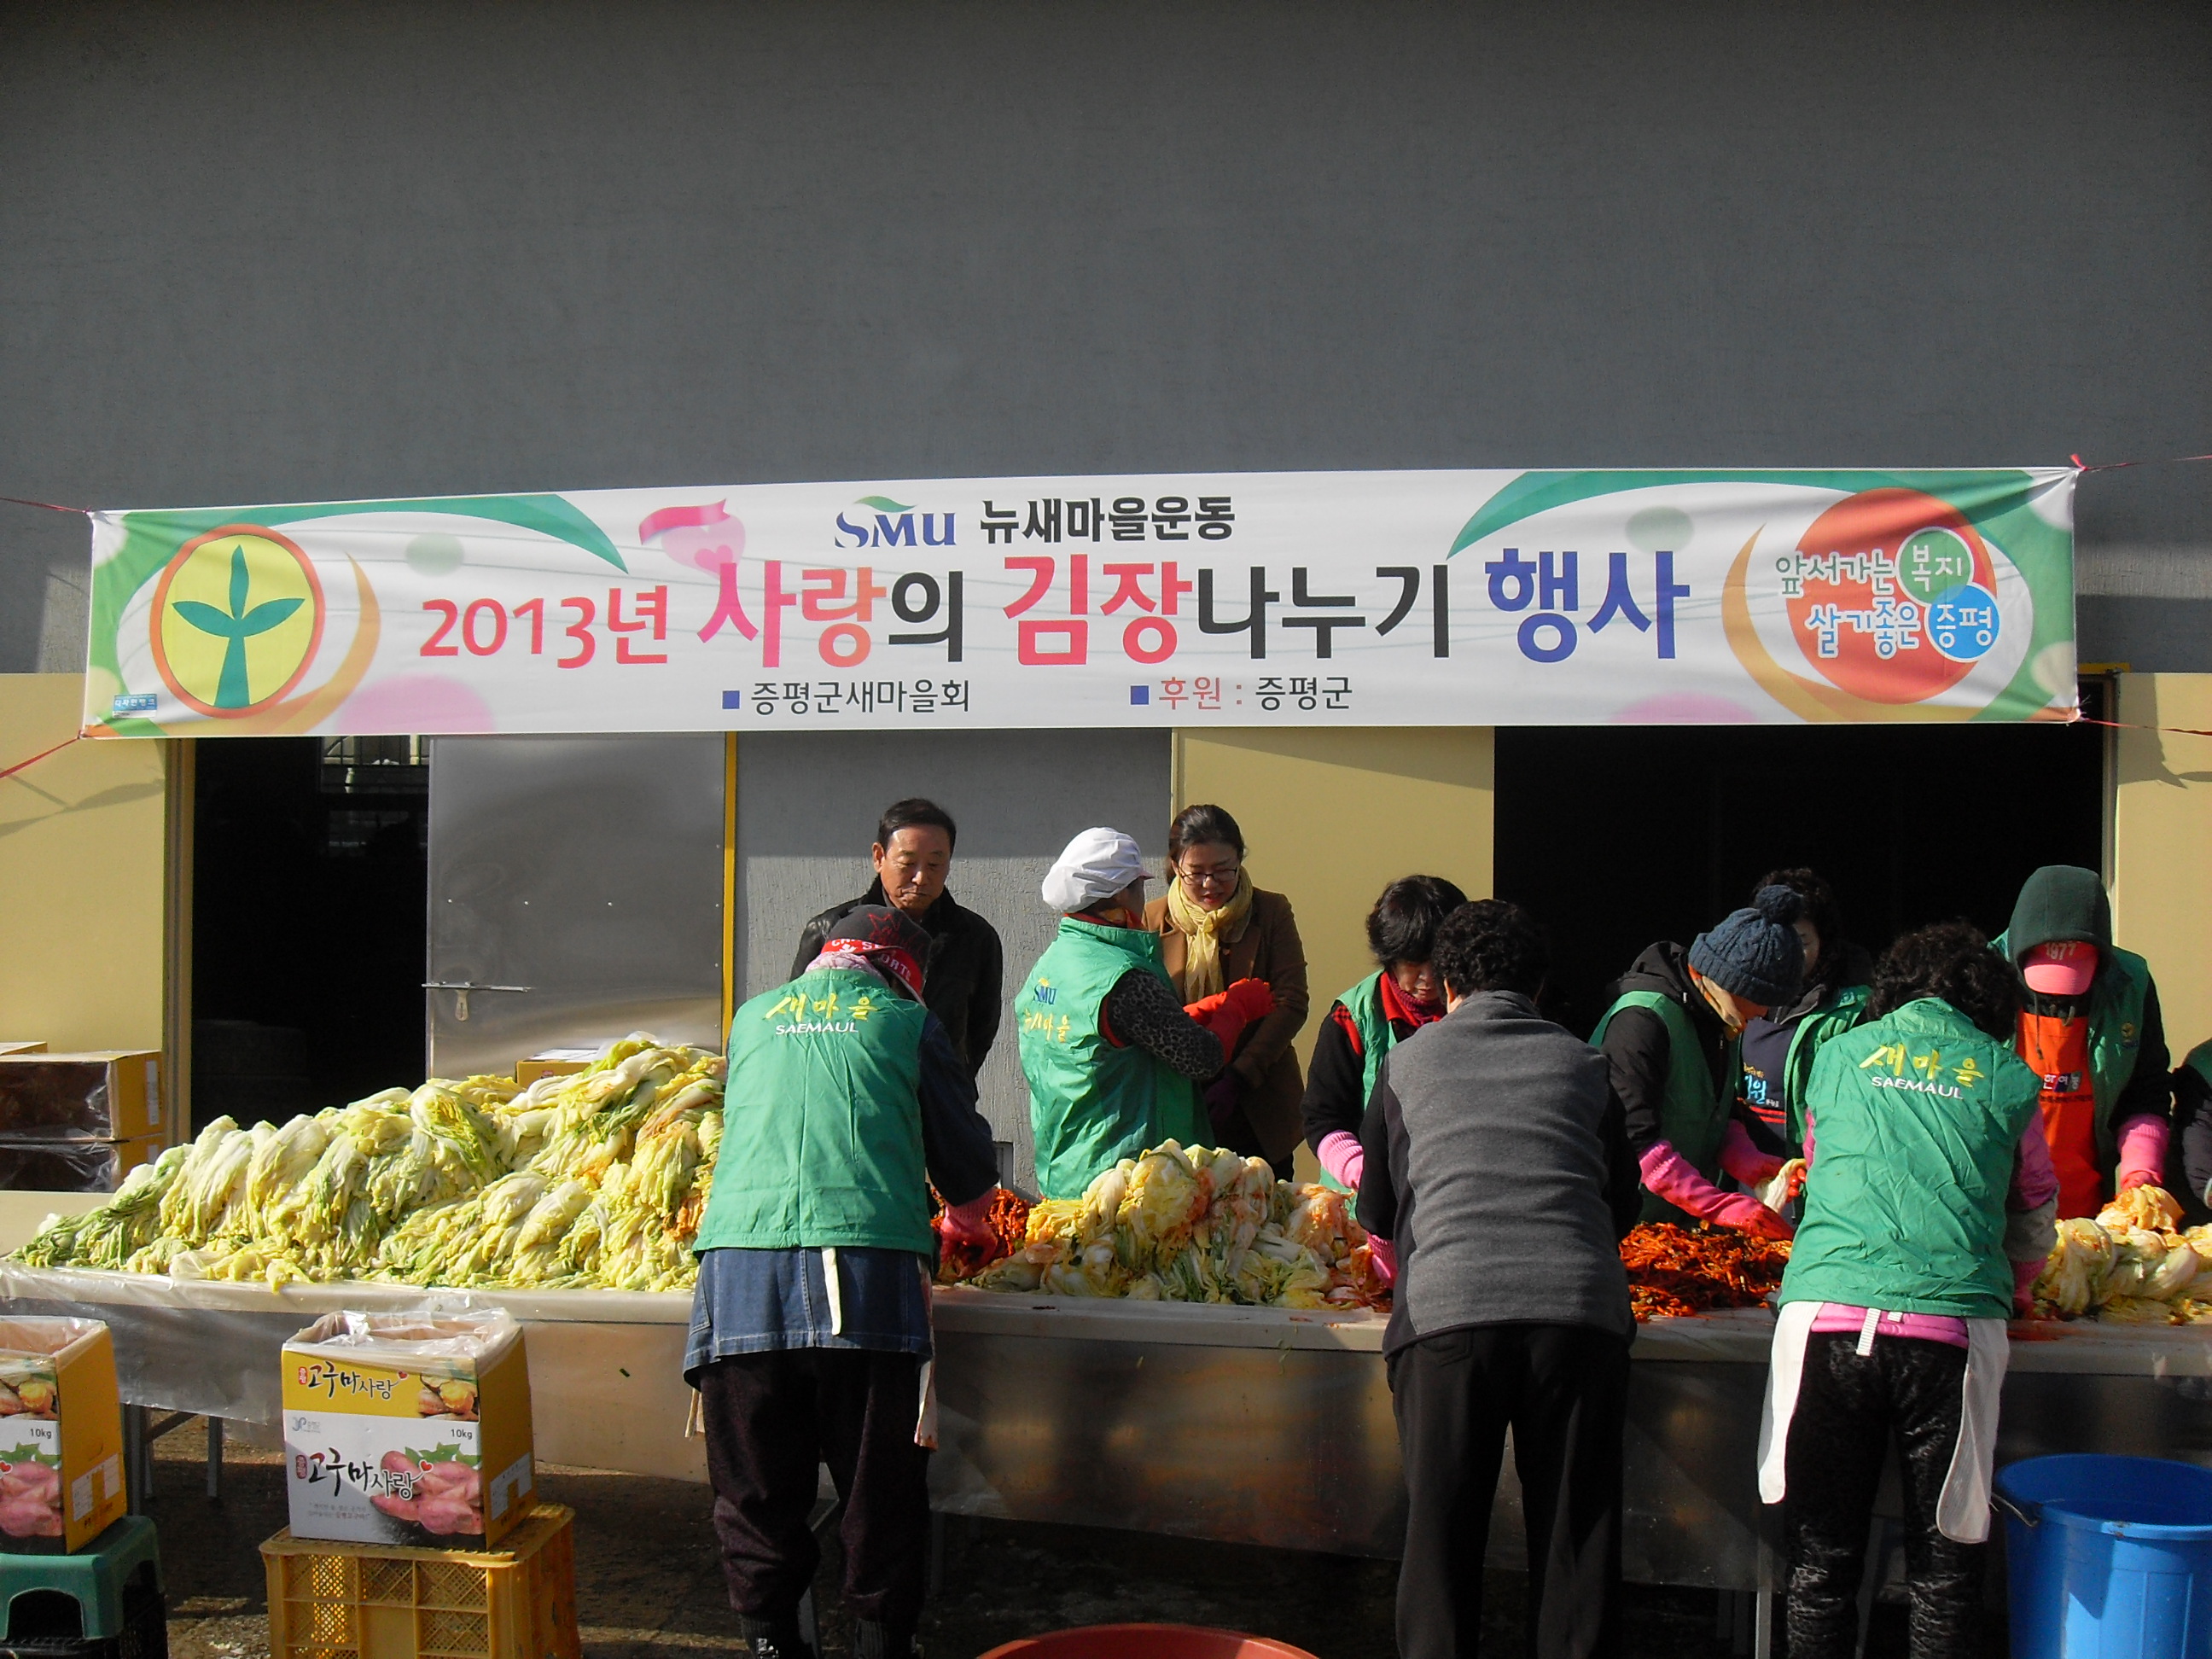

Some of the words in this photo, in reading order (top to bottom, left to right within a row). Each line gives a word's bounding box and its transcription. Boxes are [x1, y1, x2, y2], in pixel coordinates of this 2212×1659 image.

[979, 495, 1236, 544] 뉴새마을운동
[1775, 548, 1893, 595] 앞서가는
[1911, 544, 1962, 593] 복지
[418, 584, 669, 670] 2013년
[697, 559, 964, 670] 사랑의
[1484, 548, 1691, 664] 행사
[1807, 600, 1918, 655] 살기좋은
[1935, 603, 1994, 649] 증평
[750, 679, 971, 713] 증평군새마을회
[1159, 677, 1223, 711] 후원
[1254, 677, 1353, 712] 증평군
[764, 992, 878, 1022] 새마을
[775, 1022, 859, 1035] SAEMAUL
[1859, 1042, 1985, 1088] 새마을
[1871, 1076, 1964, 1099] SAEMAUL
[30, 1428, 52, 1439] 10kg
[451, 1429, 473, 1441] 10kg
